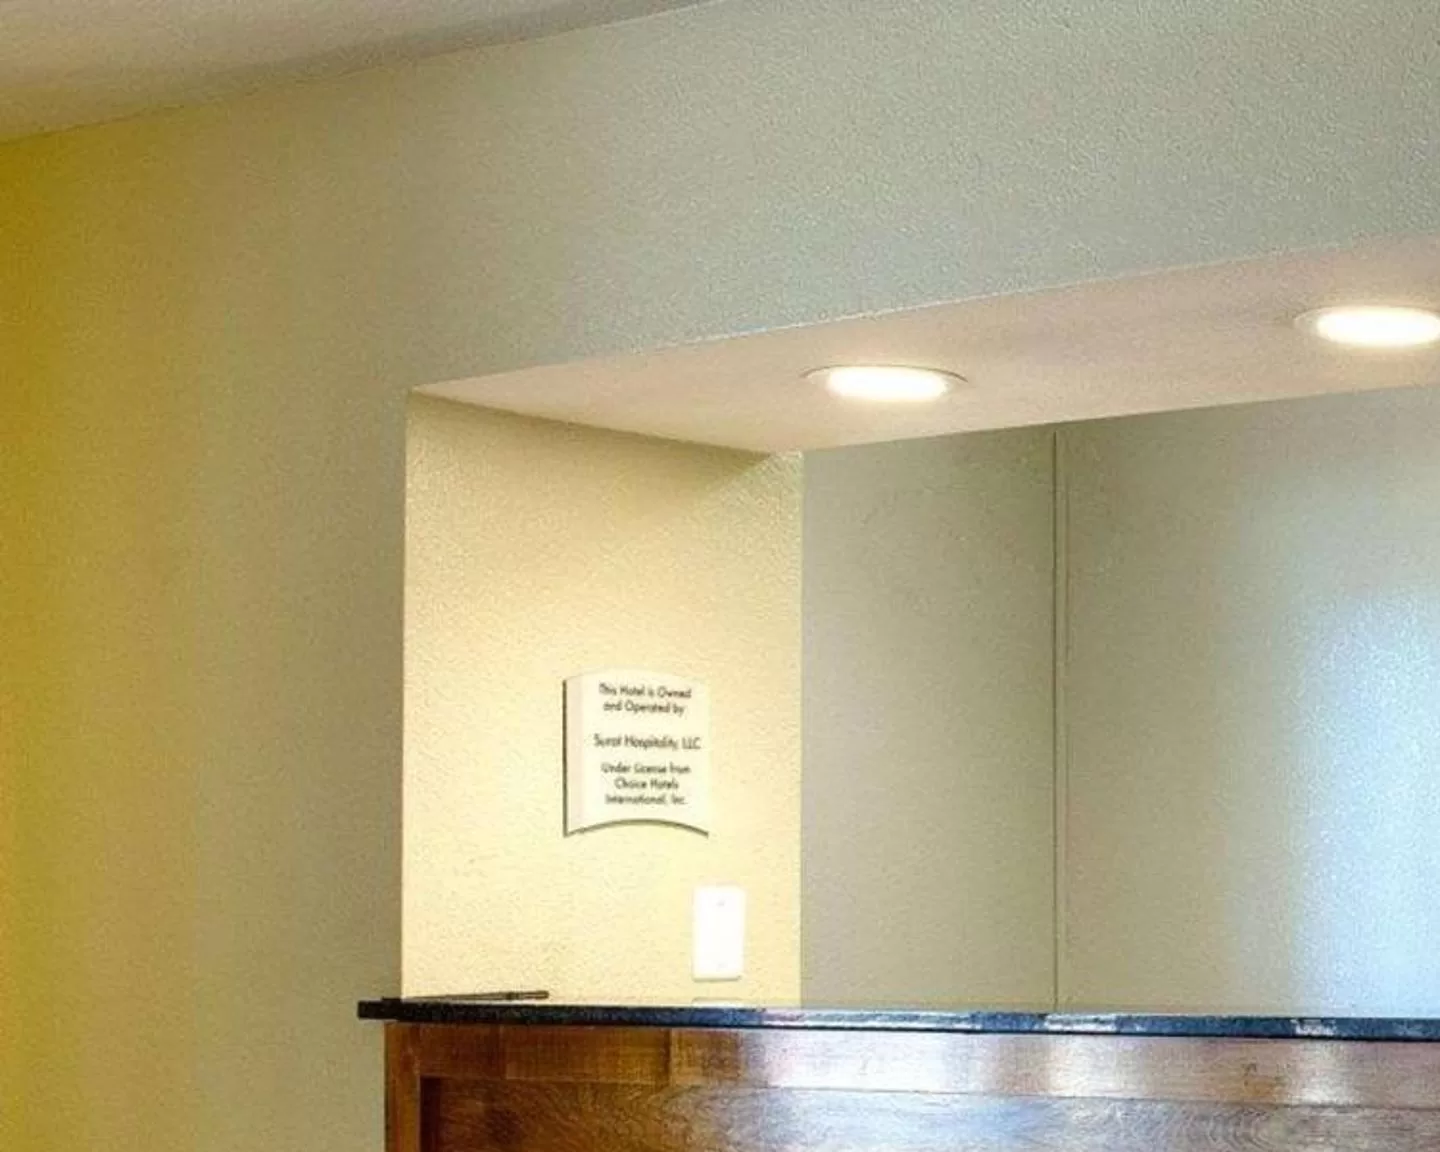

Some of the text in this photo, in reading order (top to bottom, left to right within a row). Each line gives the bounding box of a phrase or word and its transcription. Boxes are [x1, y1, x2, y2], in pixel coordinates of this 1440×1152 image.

[620, 684, 645, 696] Hotel
[657, 686, 692, 699] Owned
[603, 700, 685, 717] and Operated by
[681, 737, 702, 750] LLC
[601, 762, 631, 773] Under
[614, 777, 679, 789] Choice Hotels
